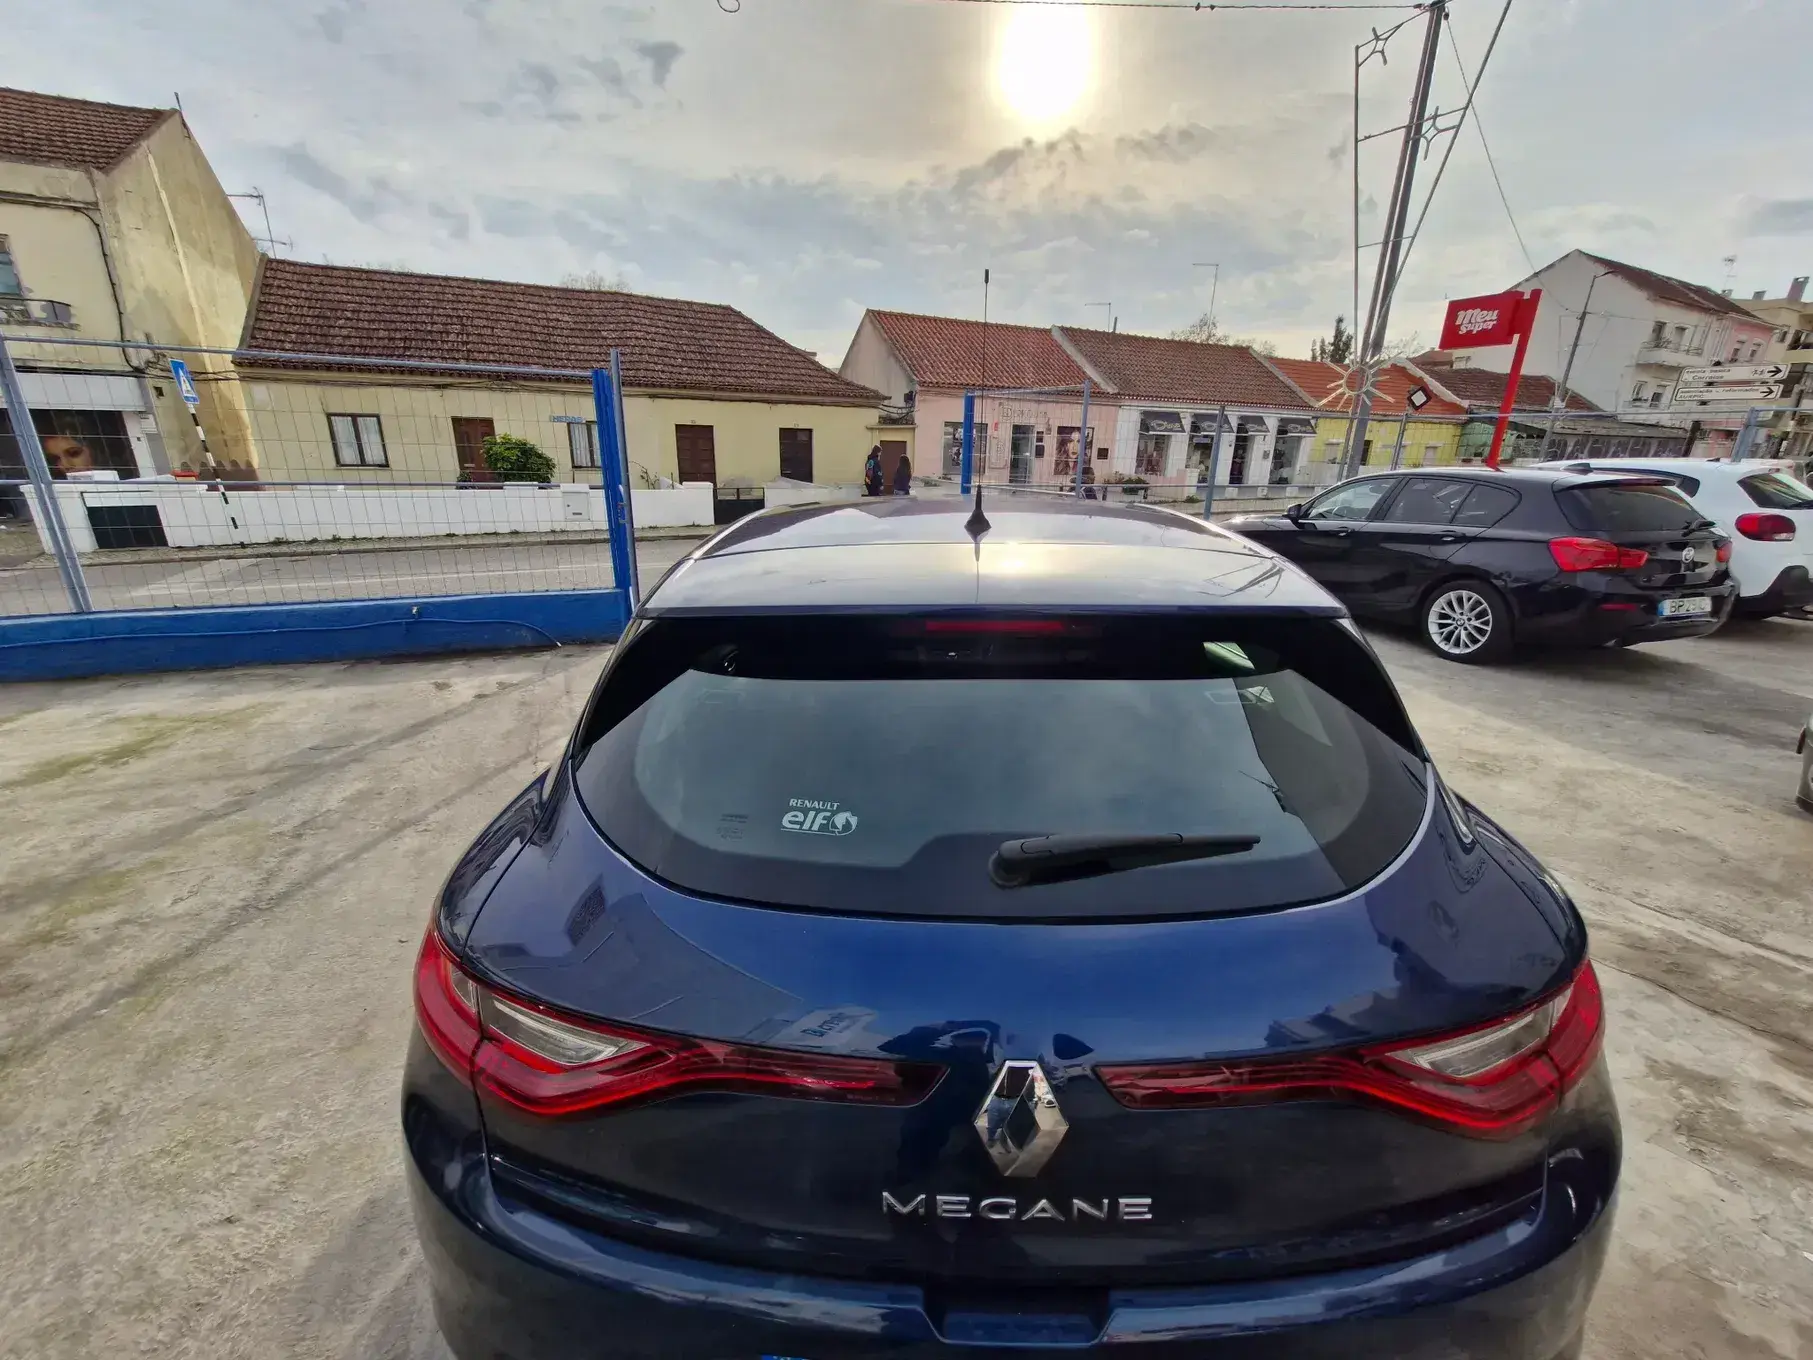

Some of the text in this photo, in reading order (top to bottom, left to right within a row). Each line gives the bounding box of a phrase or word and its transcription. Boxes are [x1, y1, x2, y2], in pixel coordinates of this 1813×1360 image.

[1455, 308, 1499, 325] Meu
[789, 798, 840, 810] RENAULT
[881, 1191, 1153, 1221] MEGANE
